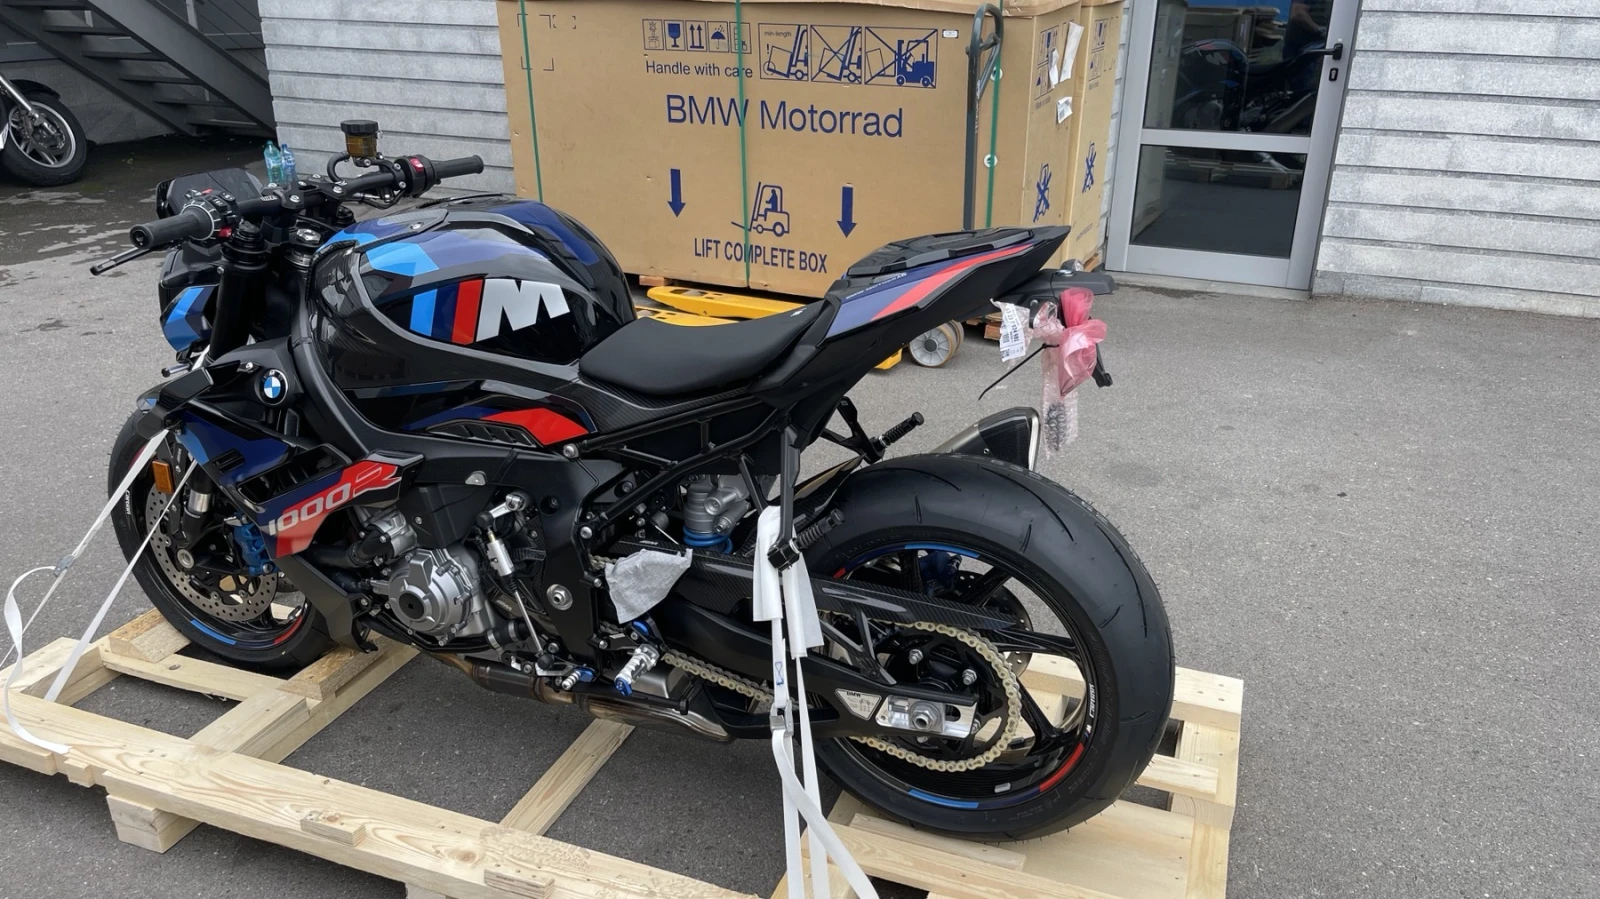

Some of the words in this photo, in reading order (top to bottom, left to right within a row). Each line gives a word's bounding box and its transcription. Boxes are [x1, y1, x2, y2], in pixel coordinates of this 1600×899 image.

[764, 30, 792, 38] min-length
[646, 60, 691, 75] Handle
[694, 61, 720, 76] with
[666, 94, 749, 127] BMW
[760, 100, 903, 138] Motorrad
[694, 237, 721, 259] LIFT
[799, 251, 828, 274] BOX
